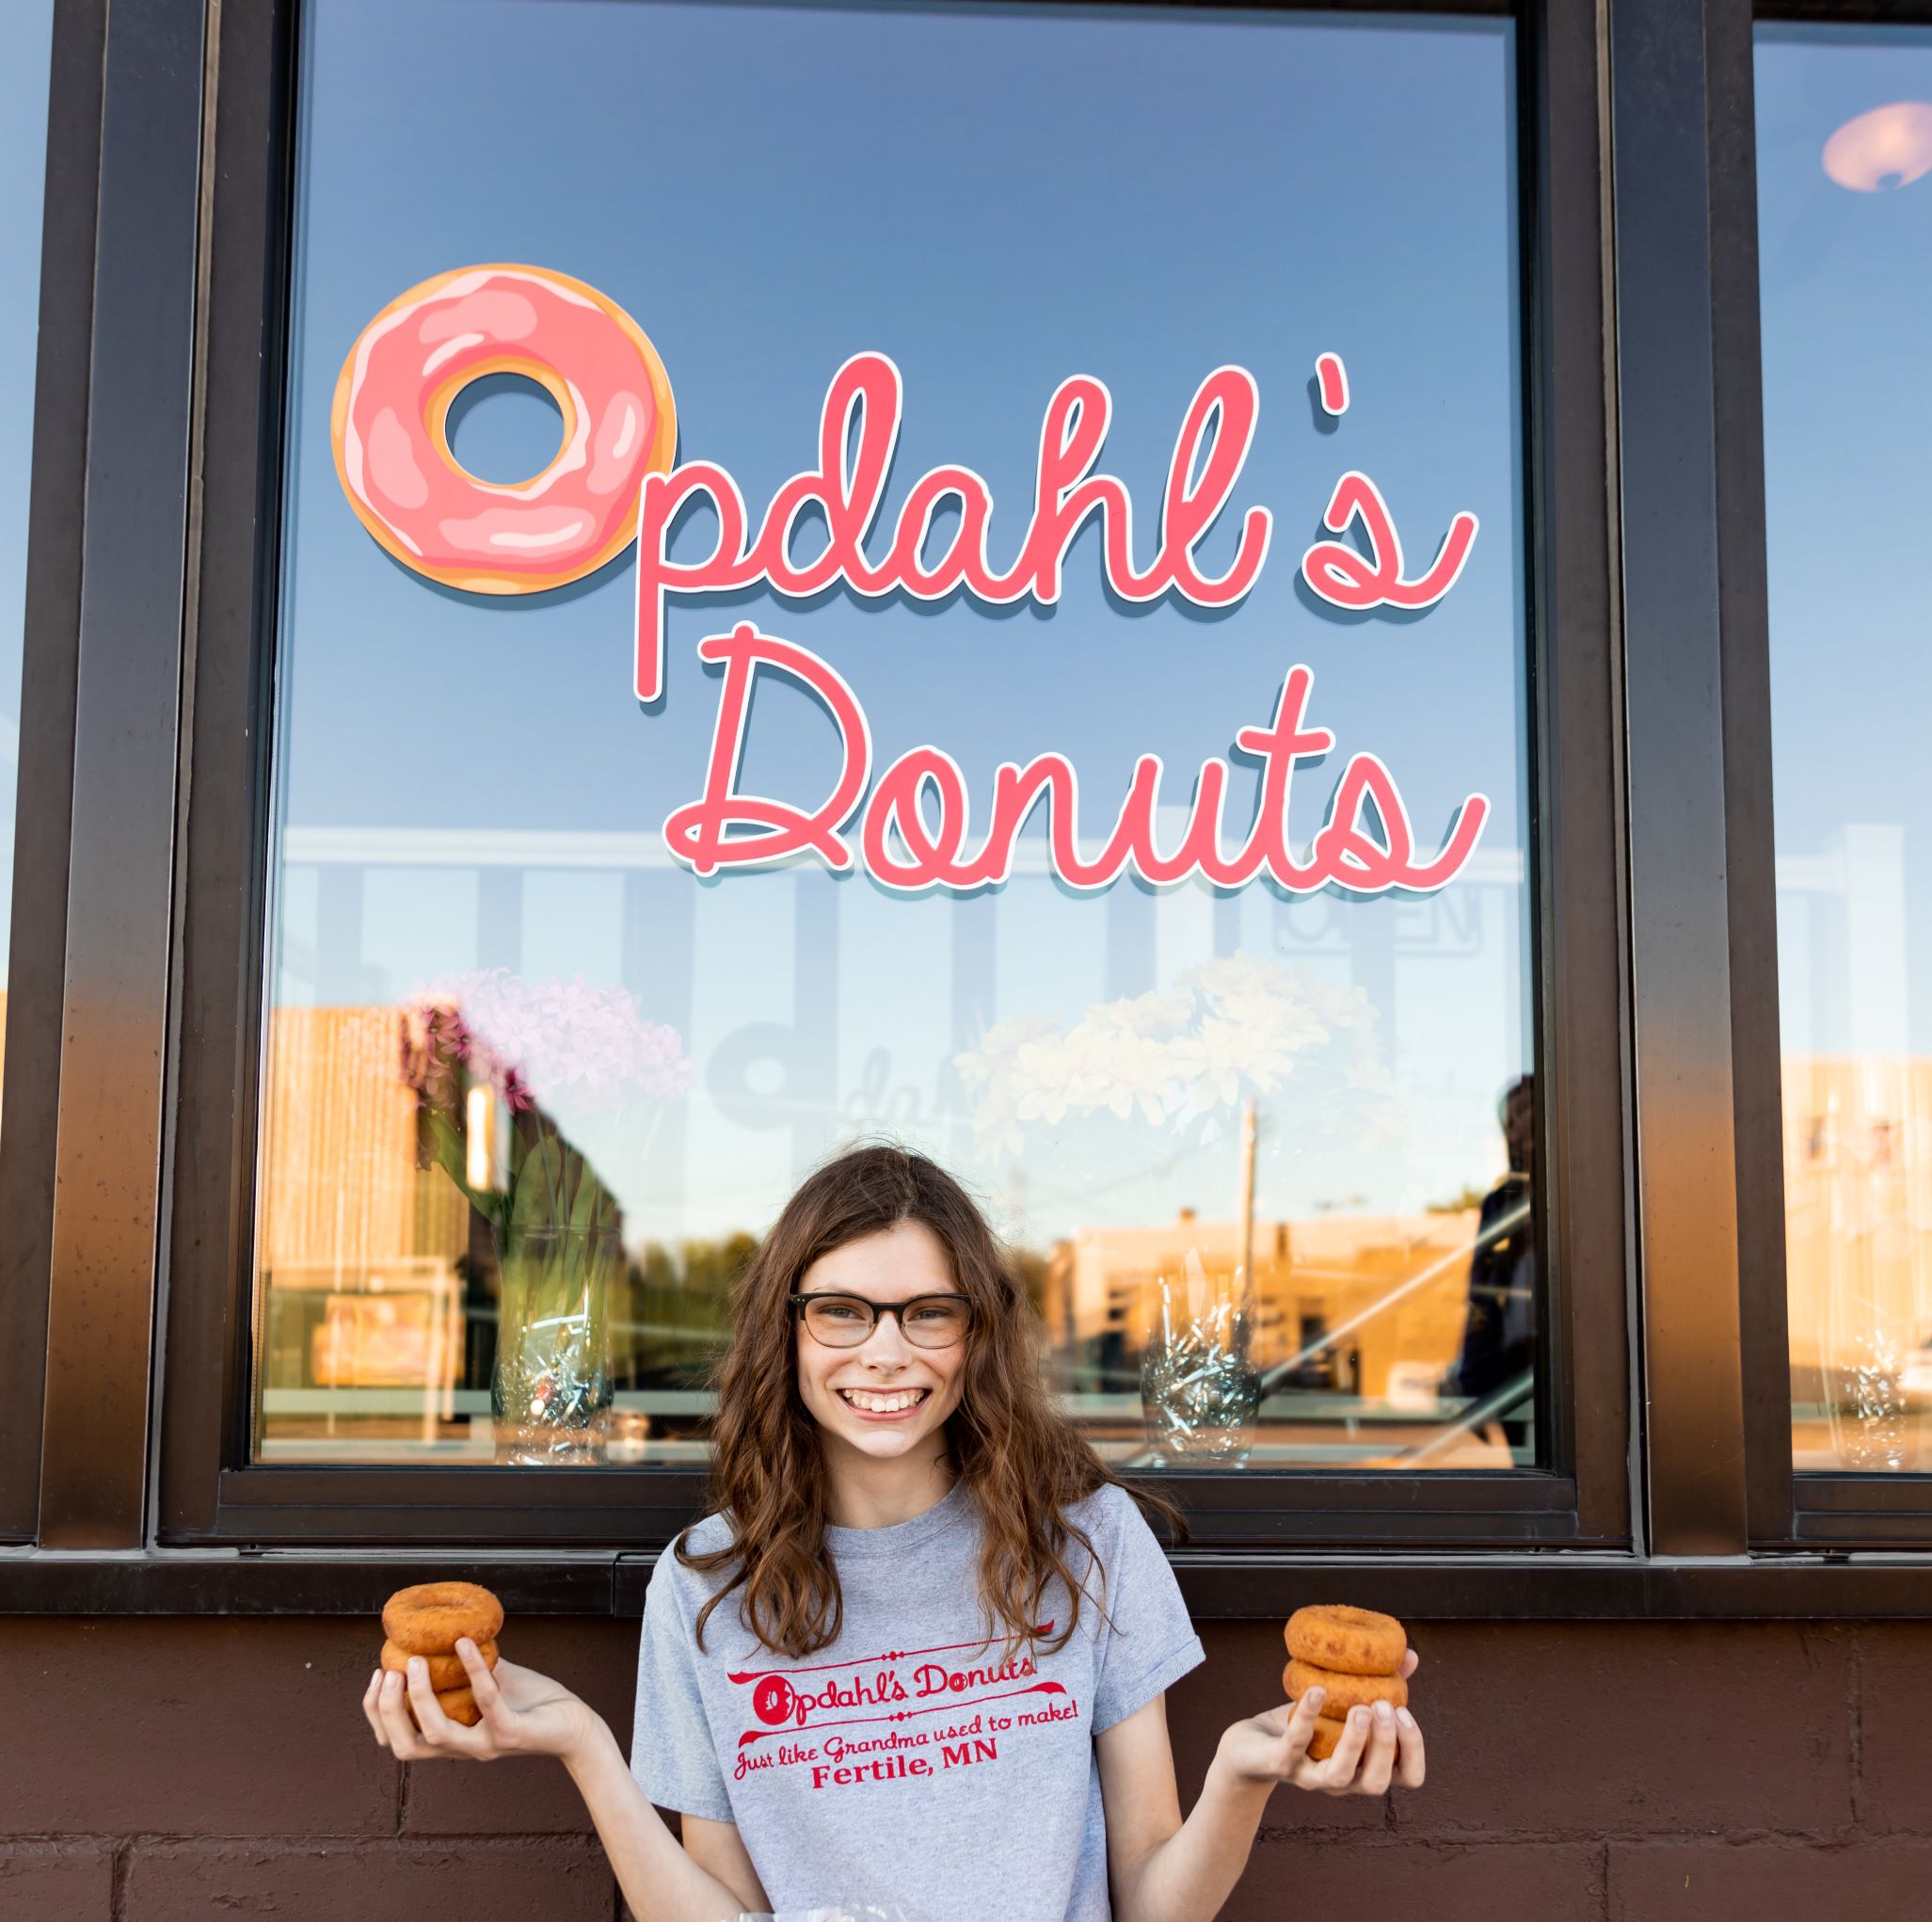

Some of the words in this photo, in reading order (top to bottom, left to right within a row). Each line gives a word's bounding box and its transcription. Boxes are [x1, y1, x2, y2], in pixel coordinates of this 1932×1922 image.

[330, 263, 1478, 702] Opdahl's
[663, 620, 1490, 893] Donuts
[752, 1670, 909, 1726] Opdahl's
[913, 1656, 1038, 1698] Donuts
[733, 1752, 774, 1781] Just
[777, 1744, 819, 1767] like
[822, 1731, 929, 1764] Grandma
[933, 1718, 982, 1742] used
[987, 1715, 1012, 1732] to
[1017, 1700, 1079, 1726] make!
[811, 1754, 935, 1789] Fertile,
[941, 1737, 998, 1770] MN
